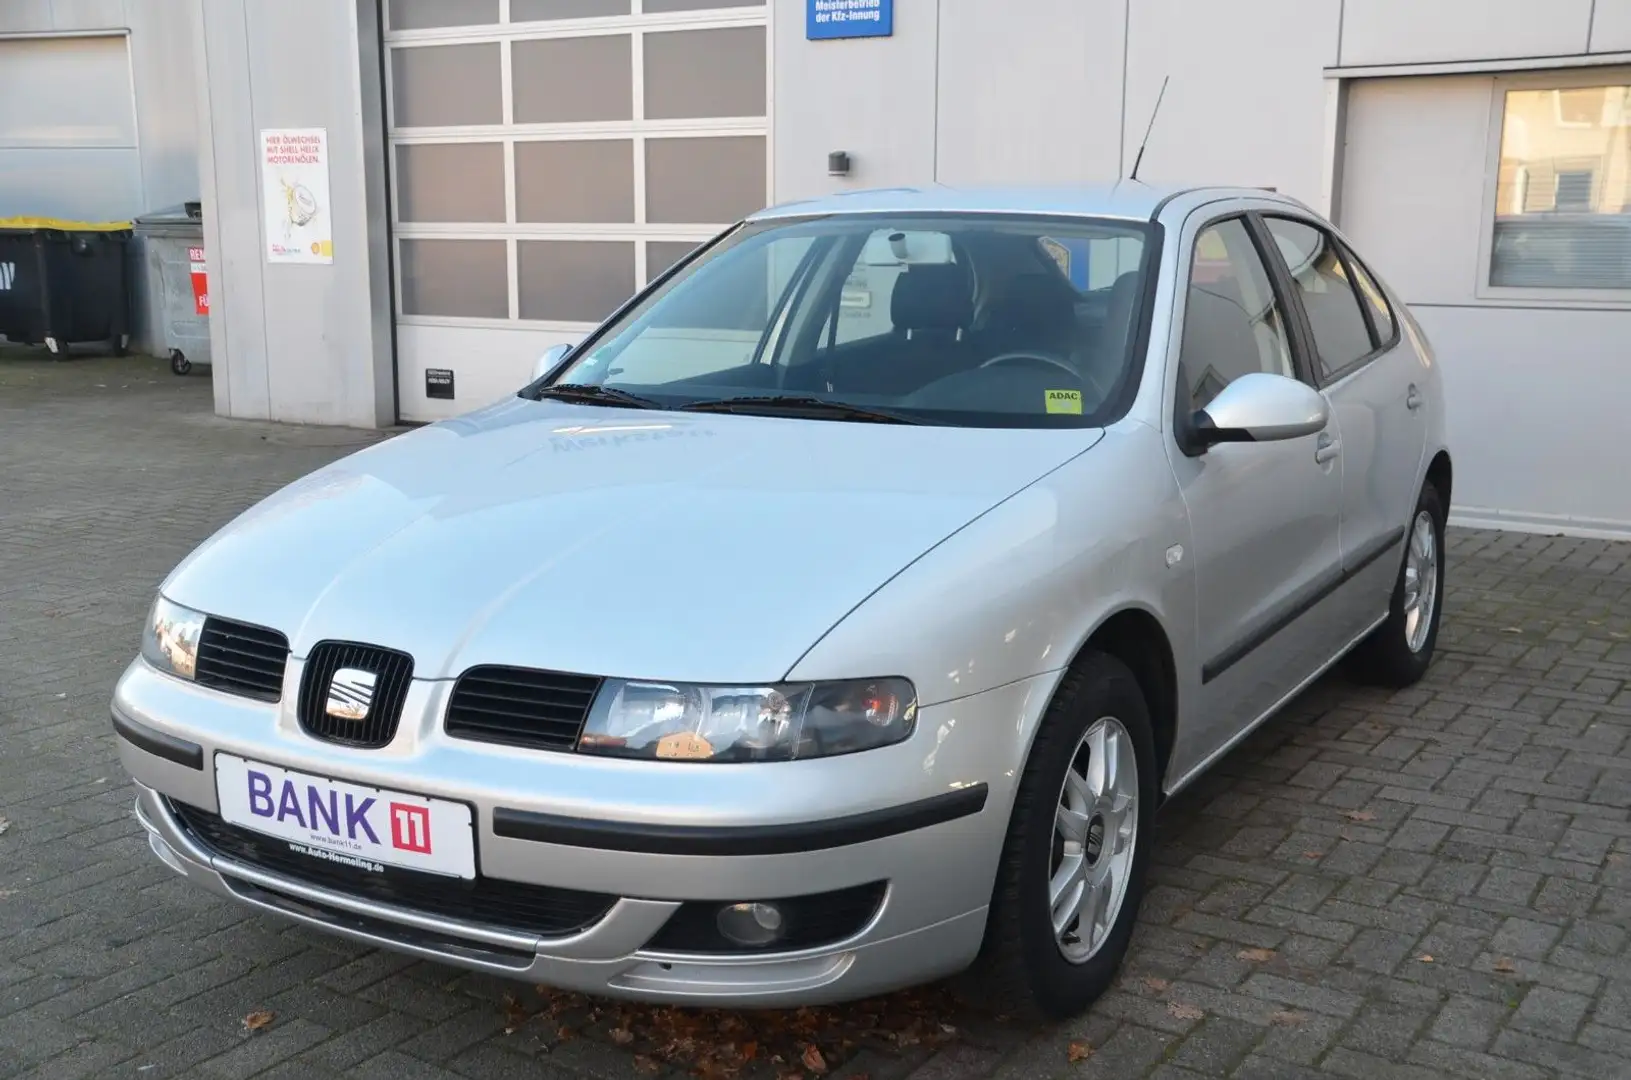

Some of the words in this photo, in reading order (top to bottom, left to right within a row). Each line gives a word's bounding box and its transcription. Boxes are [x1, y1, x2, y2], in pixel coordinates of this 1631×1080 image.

[816, 0, 880, 11] Meisterbetrieb
[816, 12, 830, 23] der
[832, 10, 880, 21] Kfz-Innung
[280, 145, 298, 154] SHELL
[1049, 392, 1078, 400] ADAC
[248, 769, 381, 845] BANK
[394, 807, 426, 850] 11
[310, 833, 362, 850] www.bank11.de
[289, 842, 384, 873] www.Auto-Hermeling.de
